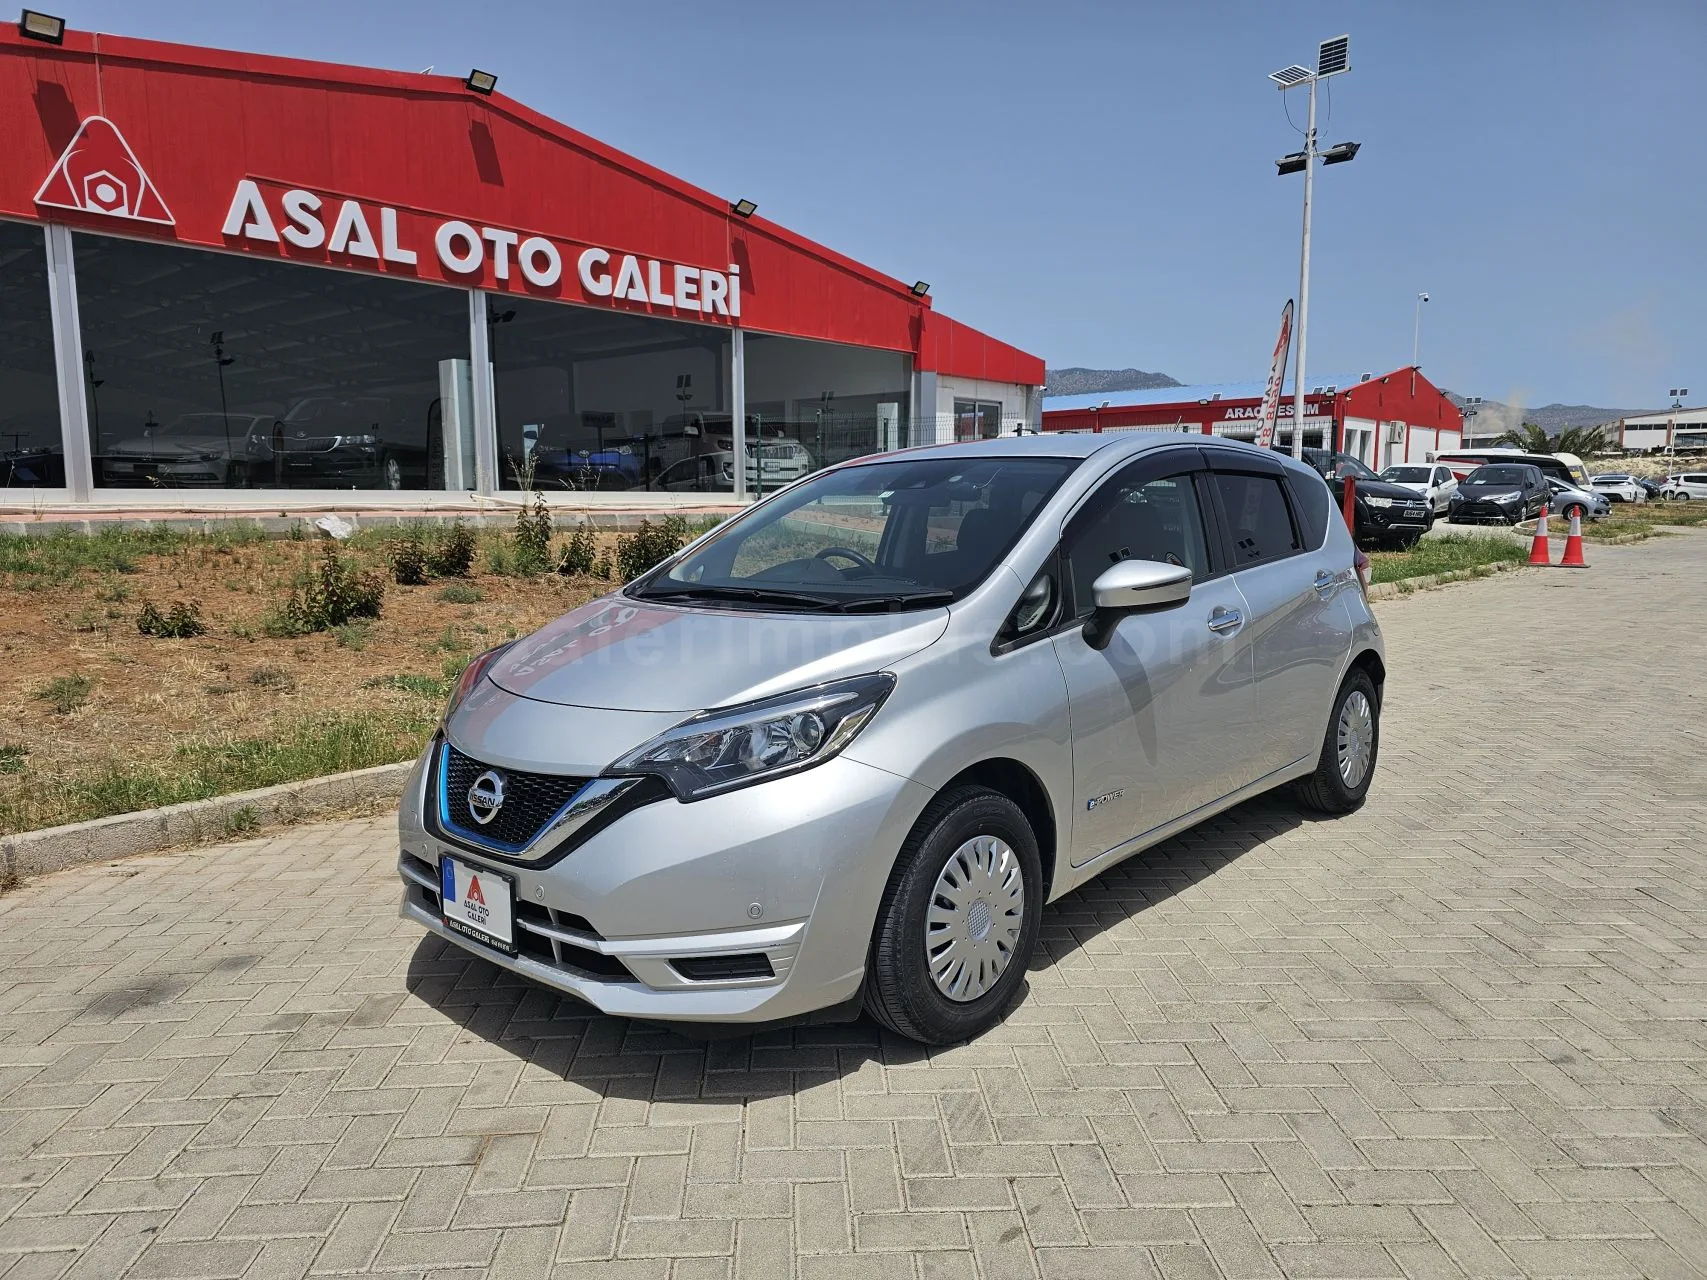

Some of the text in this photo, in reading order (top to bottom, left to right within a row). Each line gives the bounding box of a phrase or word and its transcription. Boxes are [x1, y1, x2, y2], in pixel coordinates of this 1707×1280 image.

[222, 179, 741, 318] ASAL OTO GALERİ
[1277, 402, 1319, 416] ESİM
[464, 900, 490, 917] ASAL OTO
